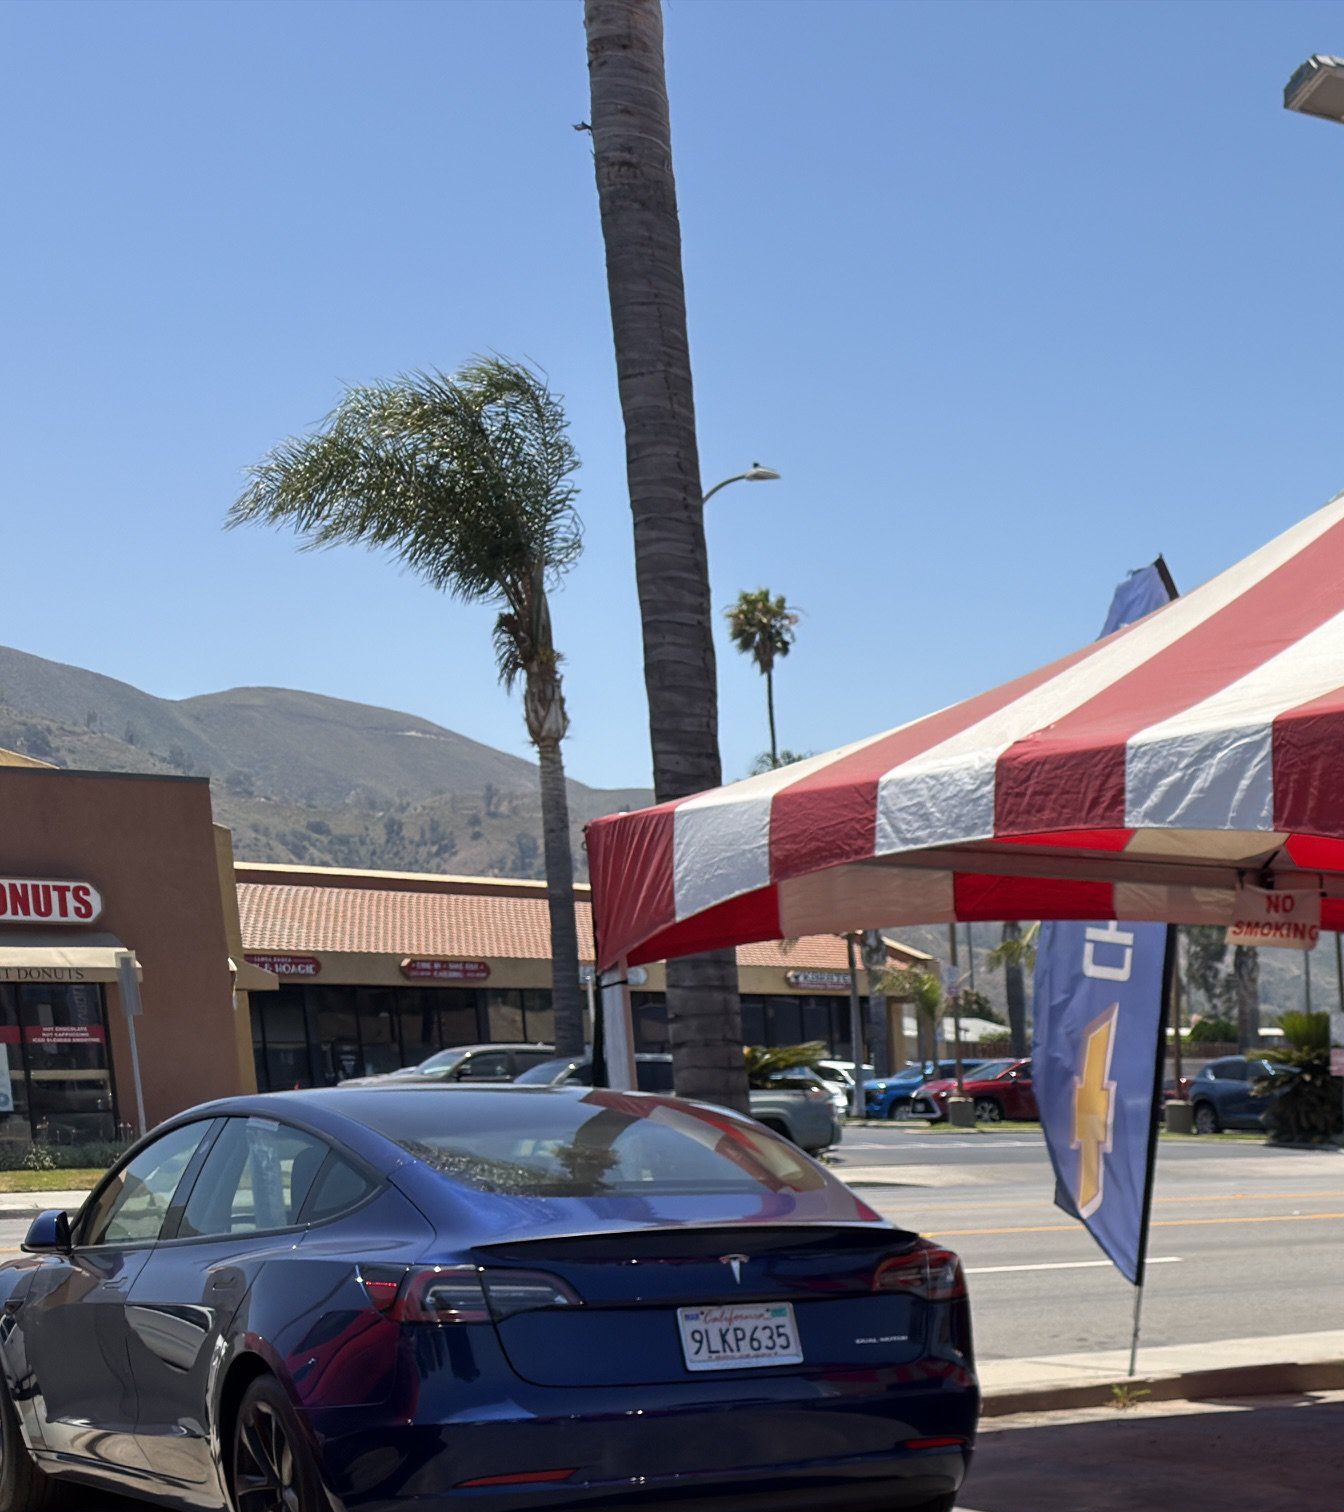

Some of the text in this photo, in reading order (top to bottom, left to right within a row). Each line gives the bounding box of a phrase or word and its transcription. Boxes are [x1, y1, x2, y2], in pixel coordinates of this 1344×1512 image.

[1265, 894, 1296, 914] NO
[1232, 920, 1319, 942] SMOKING
[17, 968, 85, 980] DONUTS
[703, 1309, 770, 1326] California
[691, 1325, 791, 1355] 9LKP635
